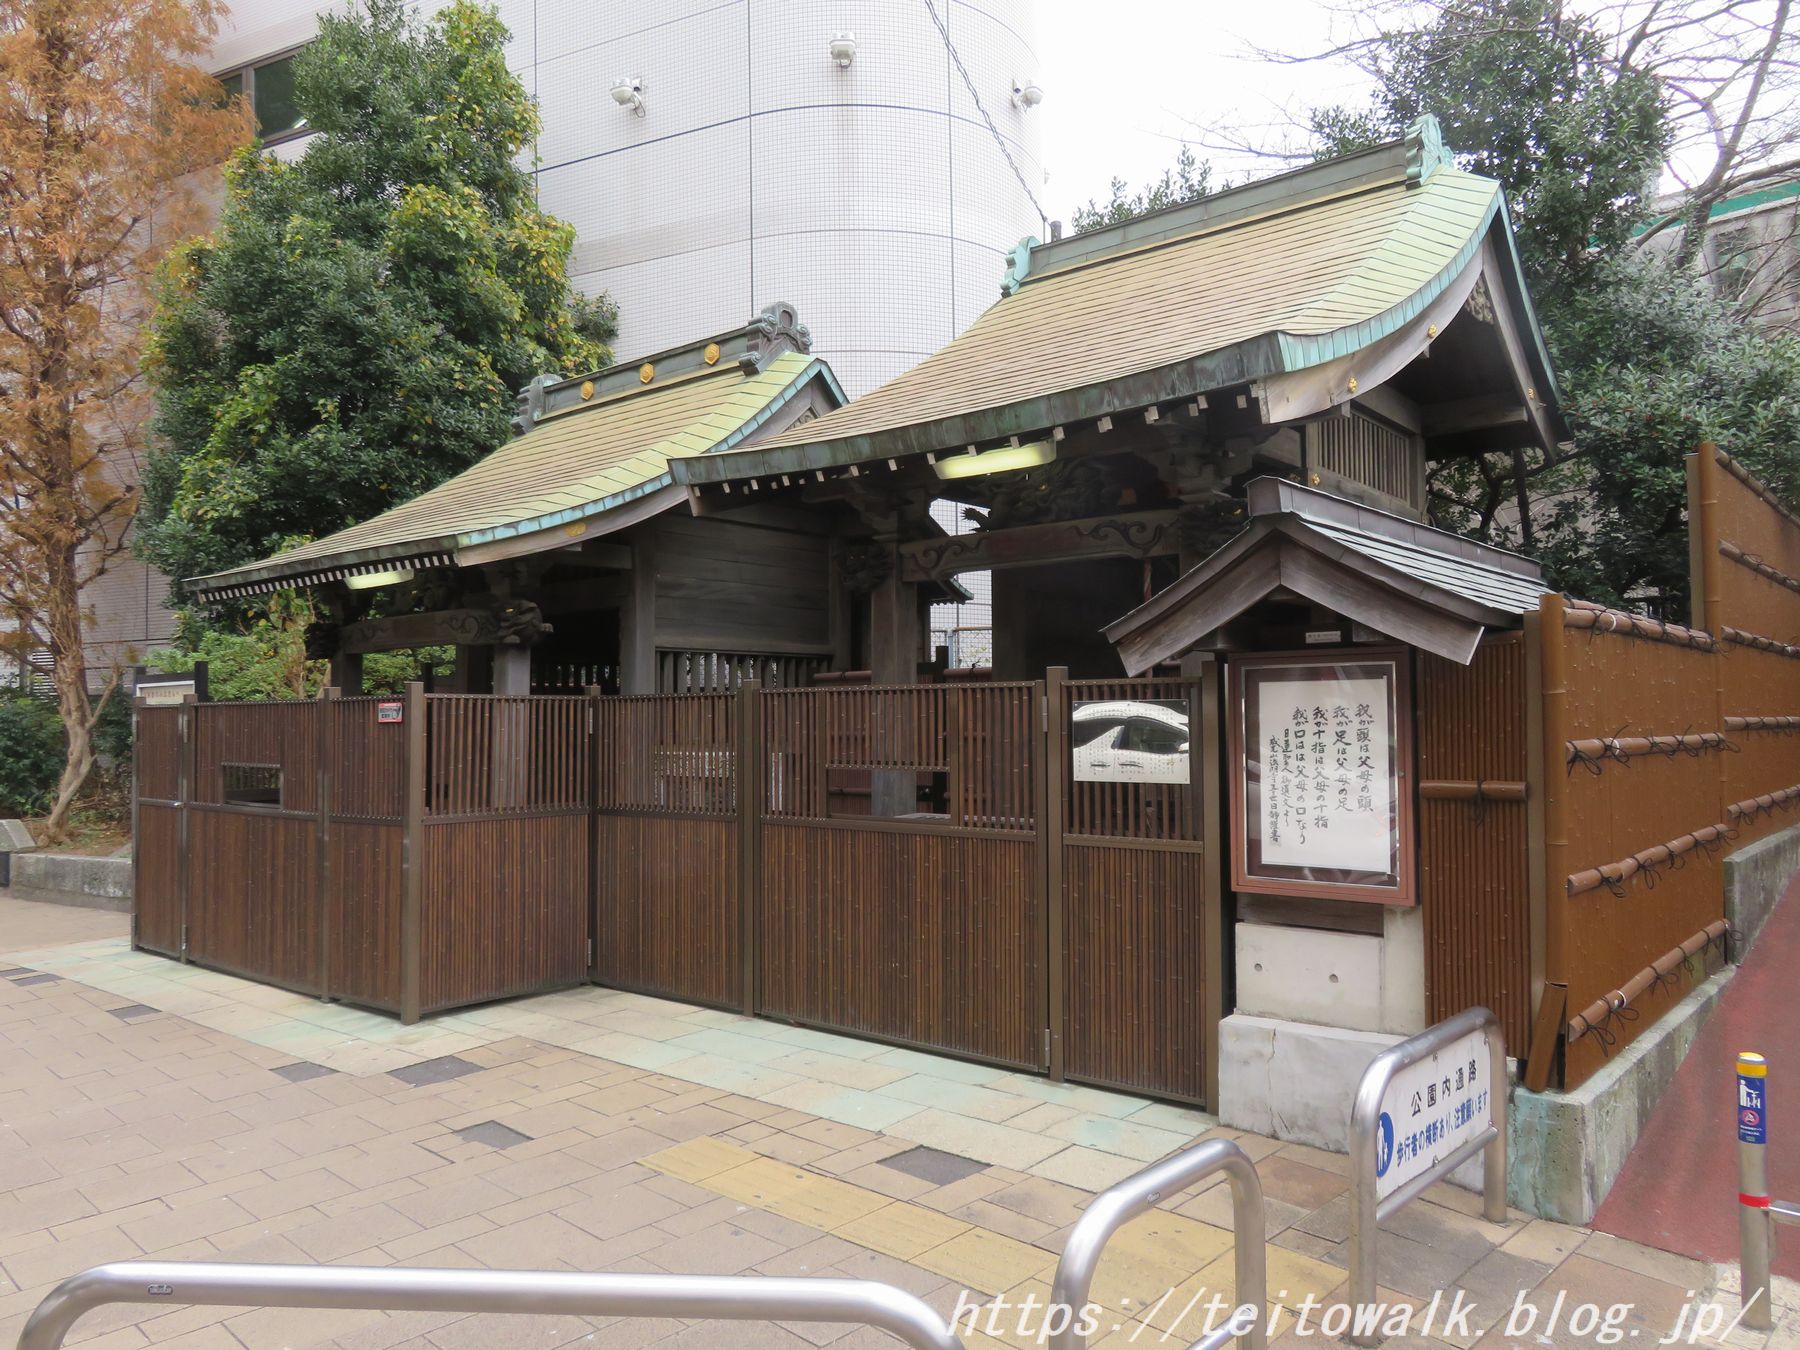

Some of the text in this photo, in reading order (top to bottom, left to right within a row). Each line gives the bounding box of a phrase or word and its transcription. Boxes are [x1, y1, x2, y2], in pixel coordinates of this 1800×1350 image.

[1411, 1059, 1477, 1117] 公園内通路
